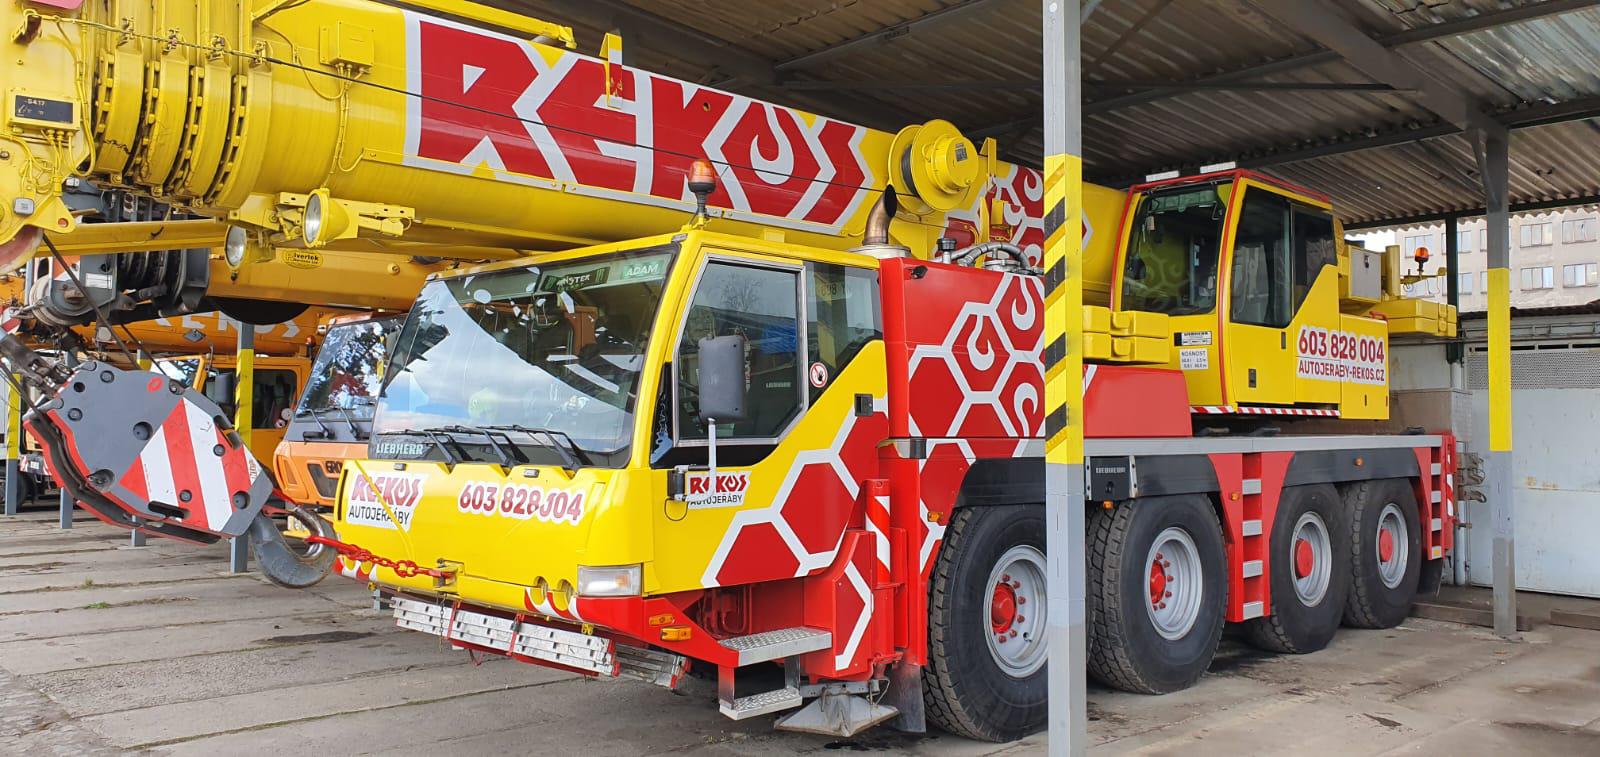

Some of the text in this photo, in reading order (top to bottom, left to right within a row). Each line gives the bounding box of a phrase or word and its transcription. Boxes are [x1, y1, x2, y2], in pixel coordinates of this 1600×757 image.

[418, 20, 867, 226] REKOS
[626, 263, 659, 277] ADAM
[1298, 329, 1385, 364] 603 828 004
[1298, 360, 1385, 382] AUTOJERABY-REKOS.CZ
[375, 443, 424, 455] LIEBHERR
[459, 484, 497, 512] 603
[501, 487, 541, 515] 828
